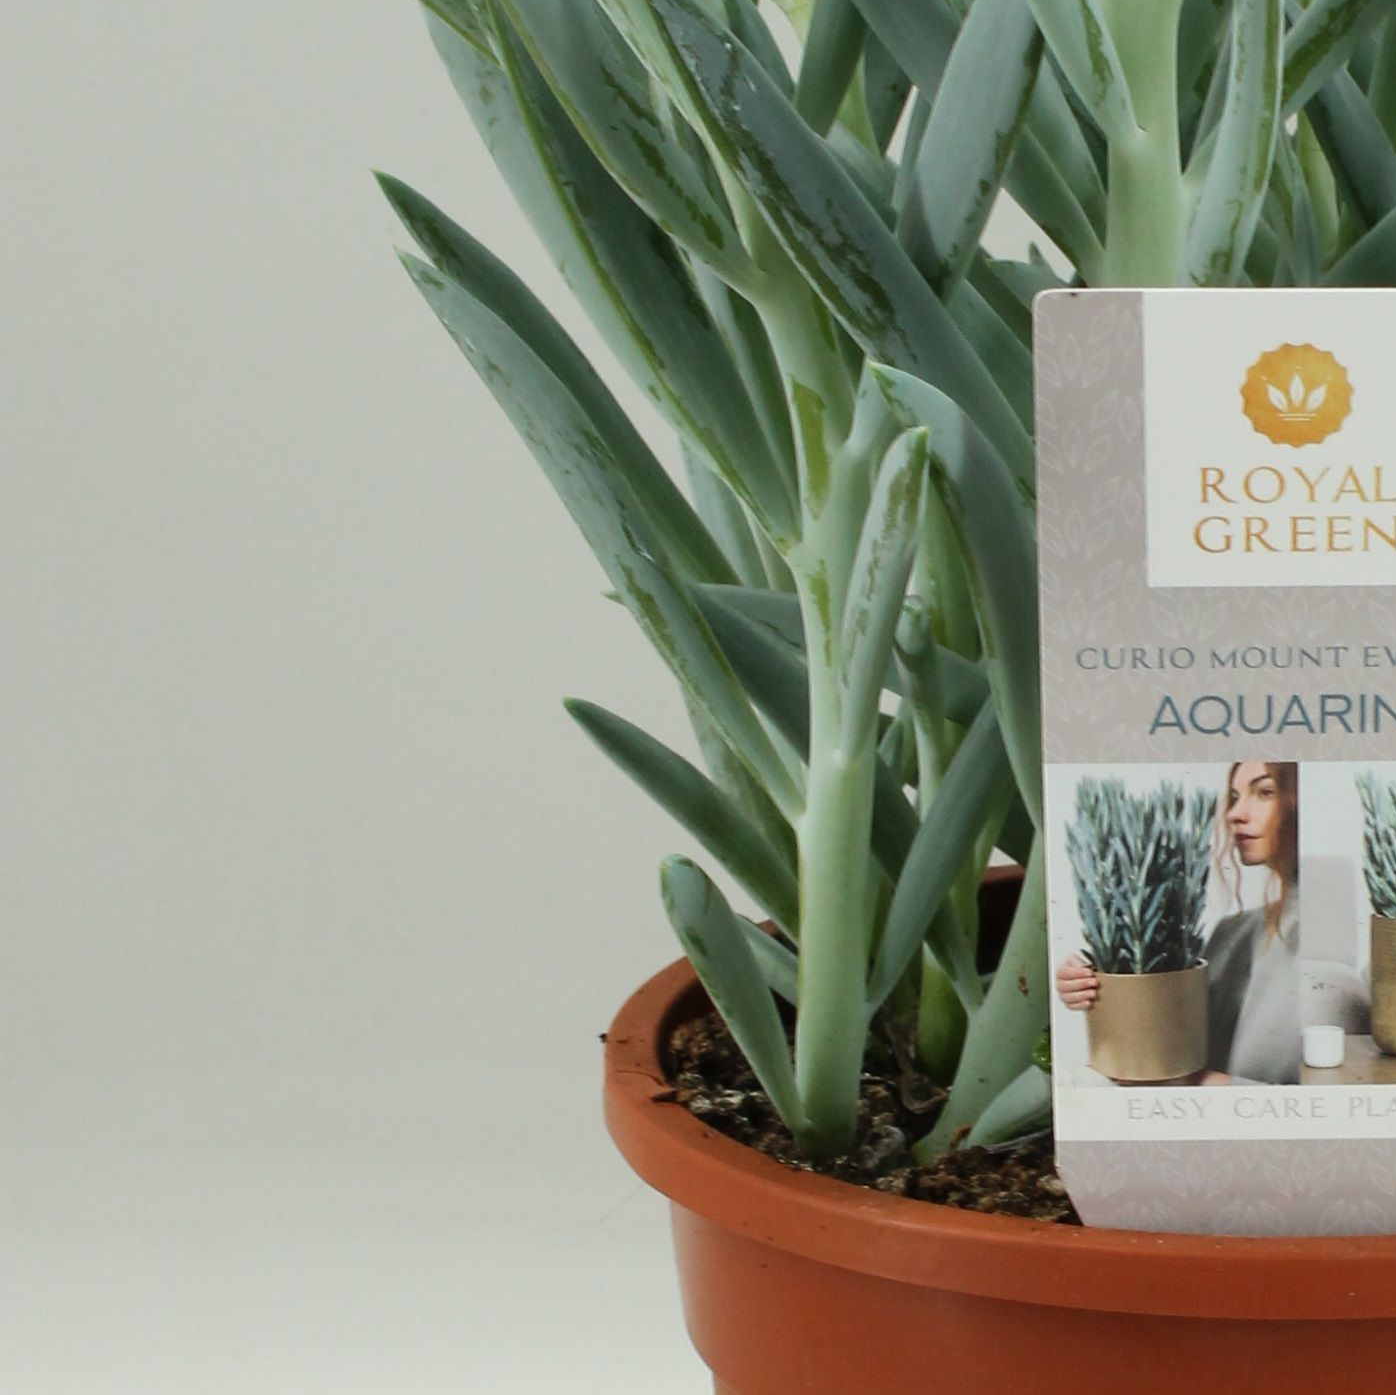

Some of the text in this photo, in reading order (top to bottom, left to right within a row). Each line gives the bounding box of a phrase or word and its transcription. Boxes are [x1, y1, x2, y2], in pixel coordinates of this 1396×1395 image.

[1075, 646, 1196, 671] CURIO
[1209, 645, 1348, 669] MOUNT
[1126, 1098, 1211, 1121] EASY
[1233, 1096, 1326, 1120] CARE
